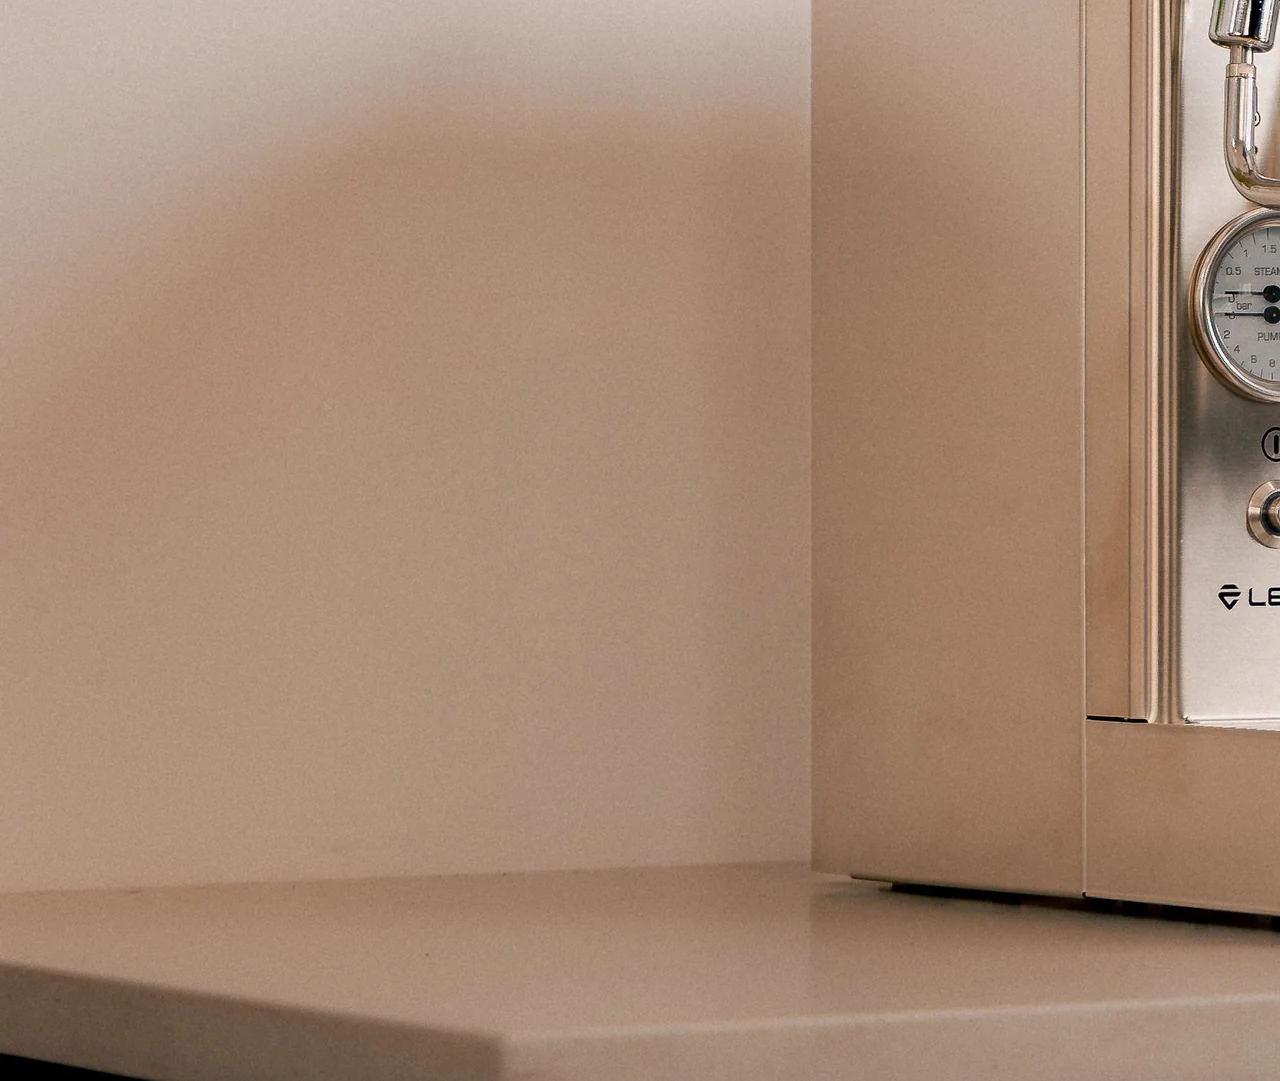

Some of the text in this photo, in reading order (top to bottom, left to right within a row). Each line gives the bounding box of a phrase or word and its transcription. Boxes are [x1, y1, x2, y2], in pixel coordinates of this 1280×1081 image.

[1243, 249, 1249, 258] 1
[1262, 244, 1277, 254] 1.5
[1225, 266, 1242, 276] 0.5
[1236, 300, 1252, 311] bar
[1223, 330, 1231, 339] 2
[1233, 344, 1241, 353] 4
[1250, 354, 1258, 364] 6
[1269, 358, 1276, 368] 8
